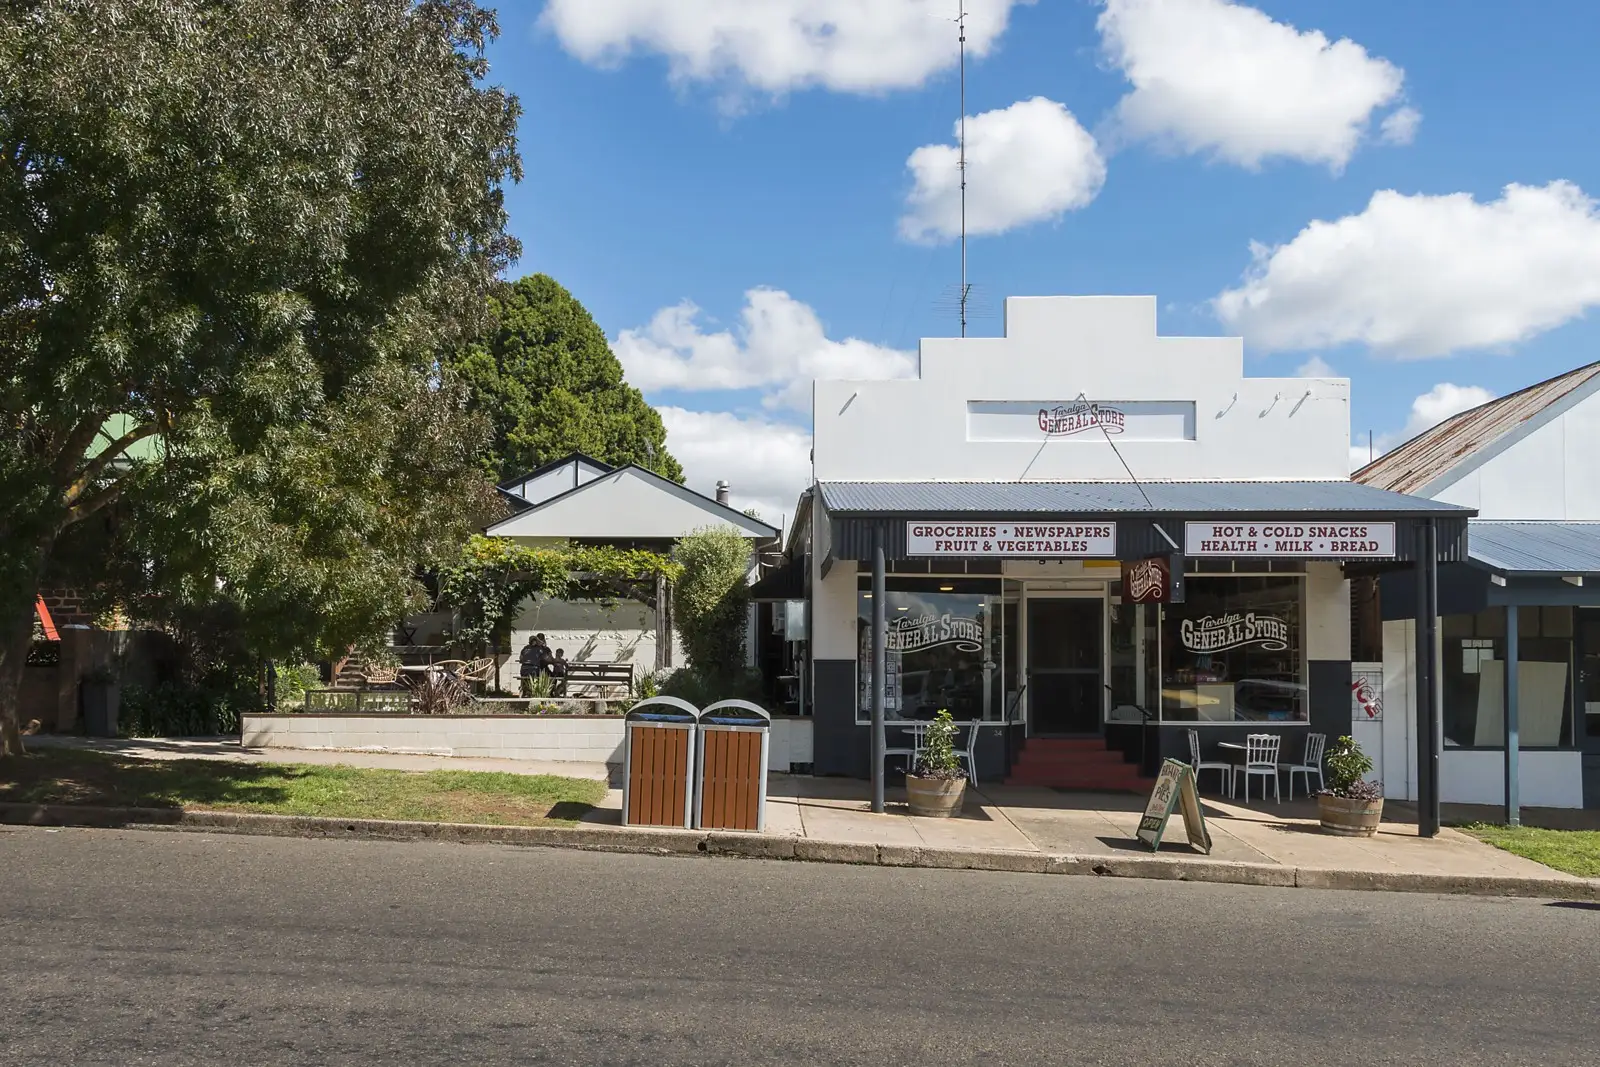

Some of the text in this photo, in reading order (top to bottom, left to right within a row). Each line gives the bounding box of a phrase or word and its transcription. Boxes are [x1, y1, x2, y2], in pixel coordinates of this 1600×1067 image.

[1038, 404, 1125, 433] GENERAL STORE
[912, 526, 1111, 538] GROCERIES NEWSPAPERS
[1212, 526, 1368, 538] HOT & COLD SNACKS
[935, 540, 1088, 552] FRUIT & VEGETABLES
[1200, 540, 1380, 552] HEALTH MILK BREAD
[892, 614, 937, 631] Taralga
[940, 613, 983, 643] STORE
[1181, 612, 1288, 650] GENERAL STORE
[1196, 613, 1241, 632] Taralga
[1352, 676, 1383, 719] ICE
[1154, 786, 1171, 804] PIES
[1142, 819, 1160, 831] OPEN
